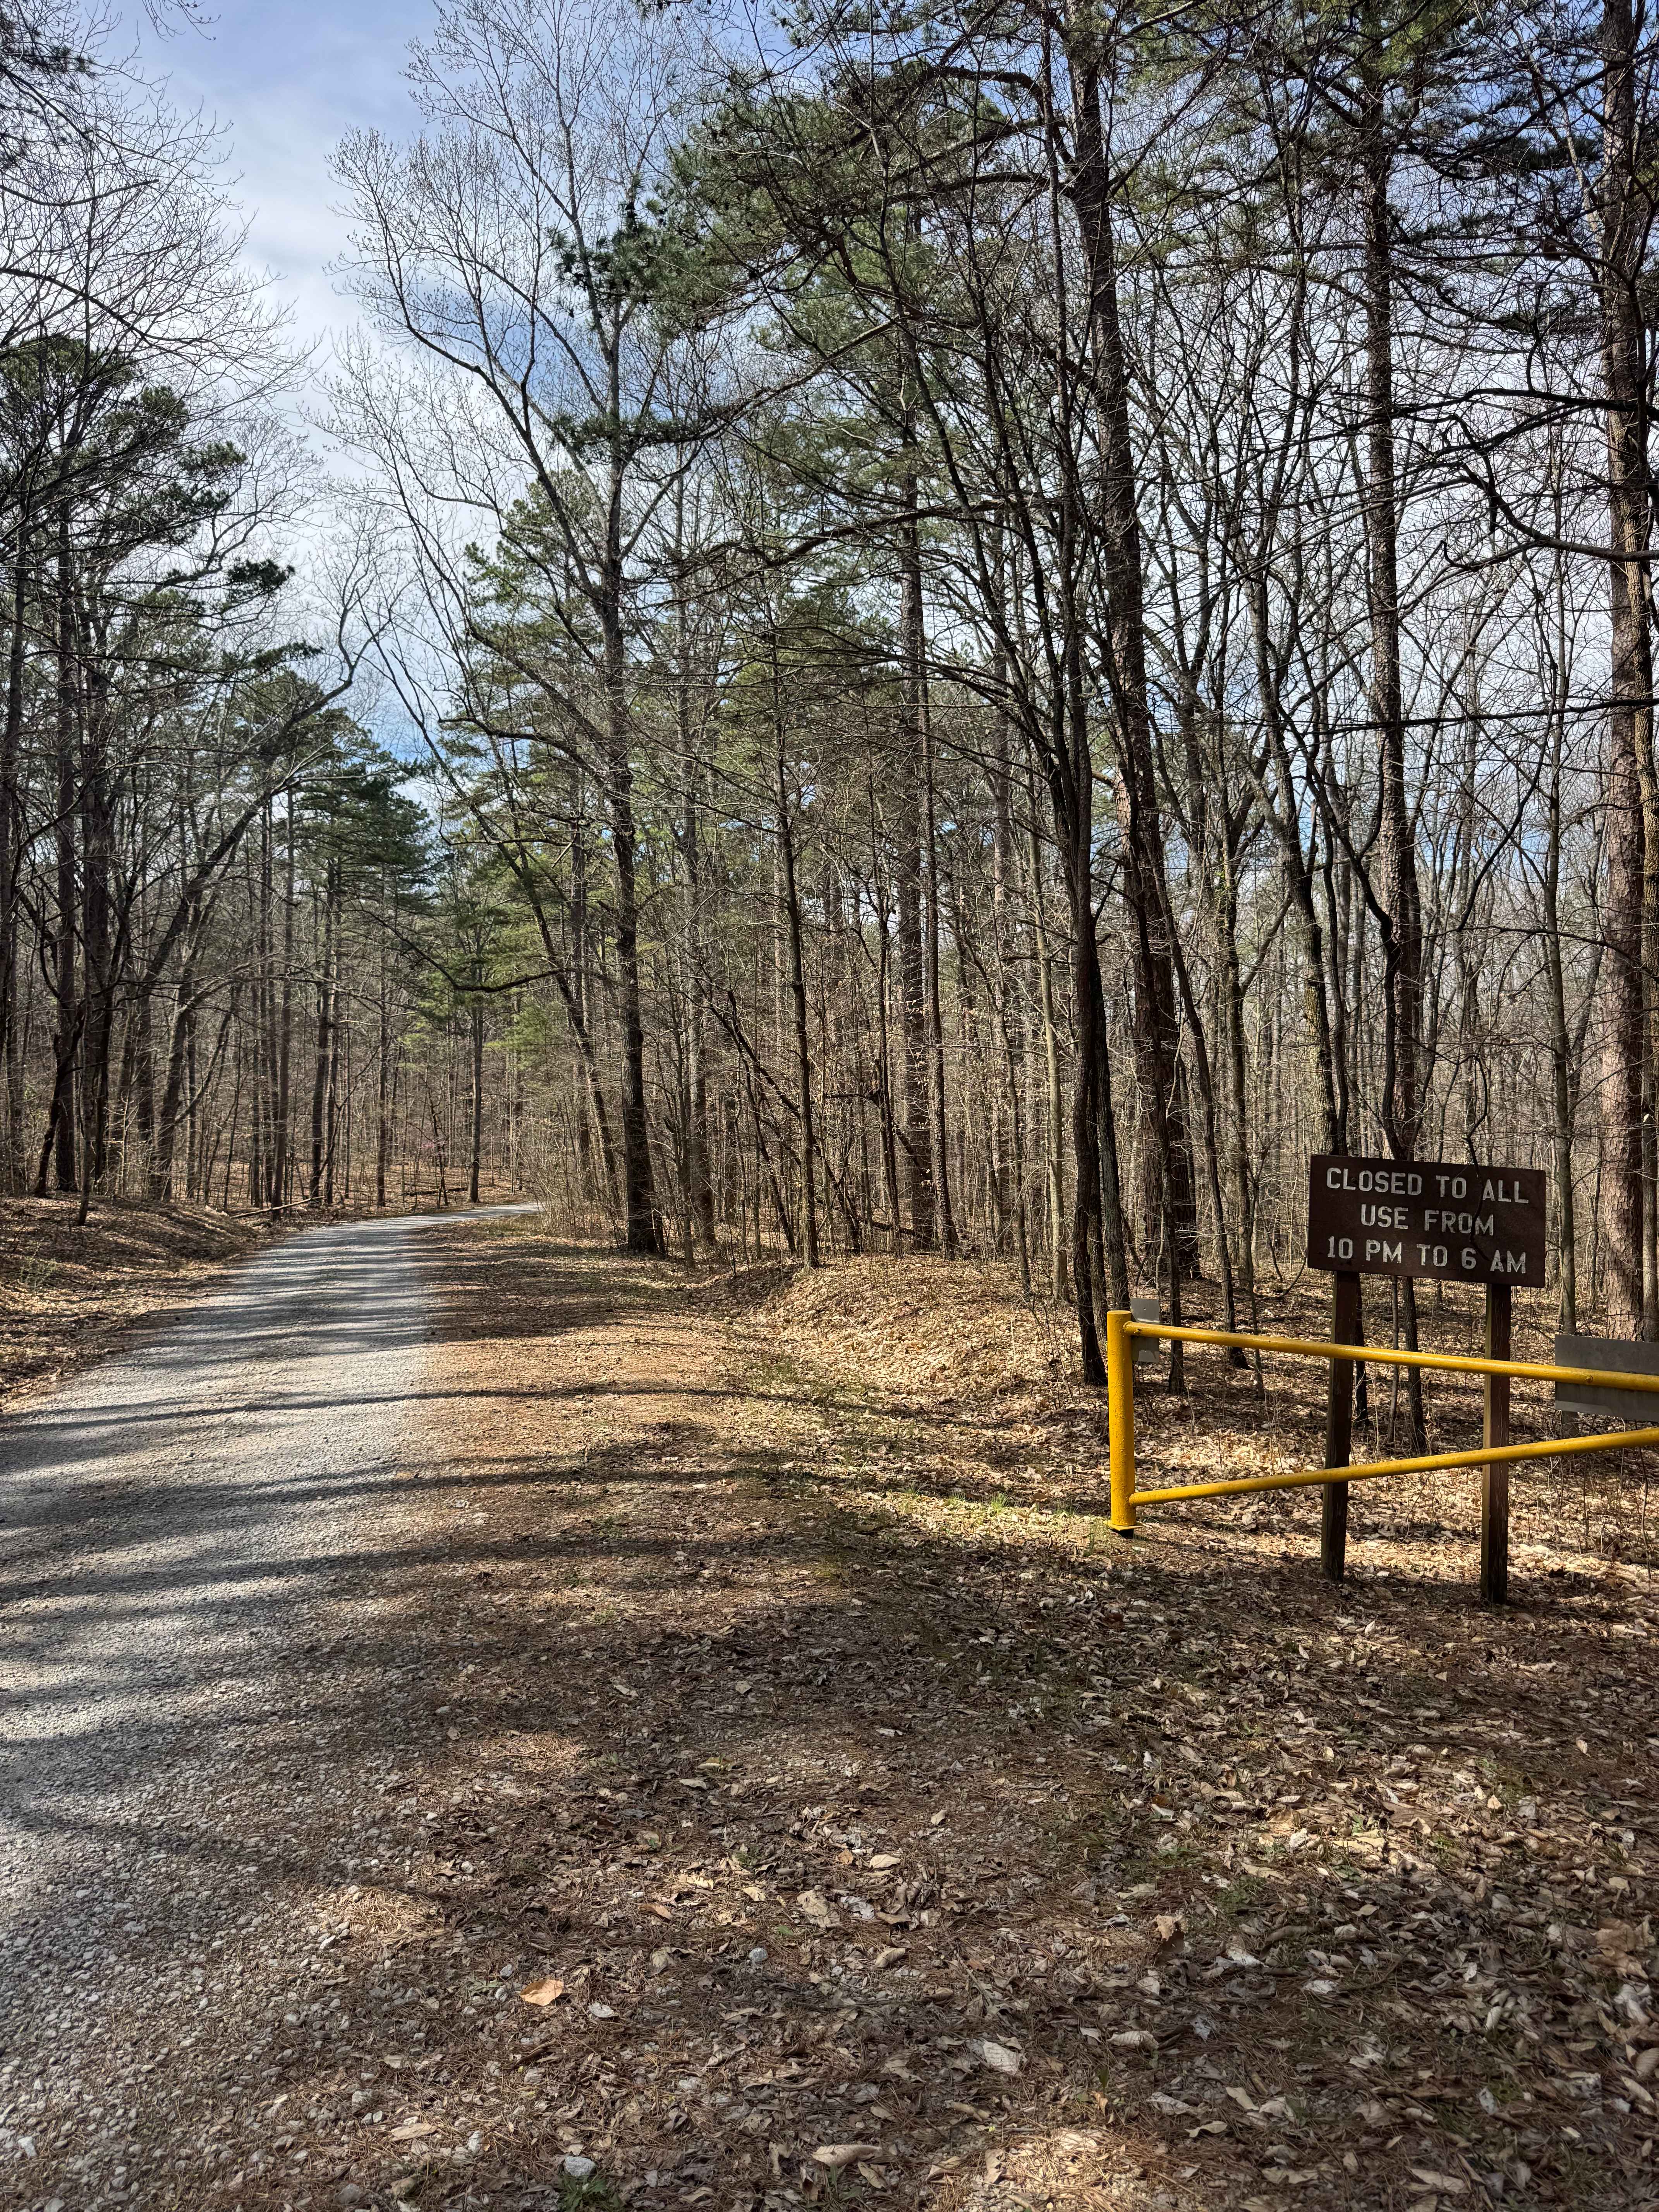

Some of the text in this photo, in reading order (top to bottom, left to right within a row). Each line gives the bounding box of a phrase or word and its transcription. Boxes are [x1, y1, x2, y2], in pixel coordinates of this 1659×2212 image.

[1326, 1167, 1529, 1204] CLOSED TO ALL
[1361, 1204, 1494, 1236] USE FROM
[1327, 1236, 1526, 1274] 10 PM TO 6 AM
